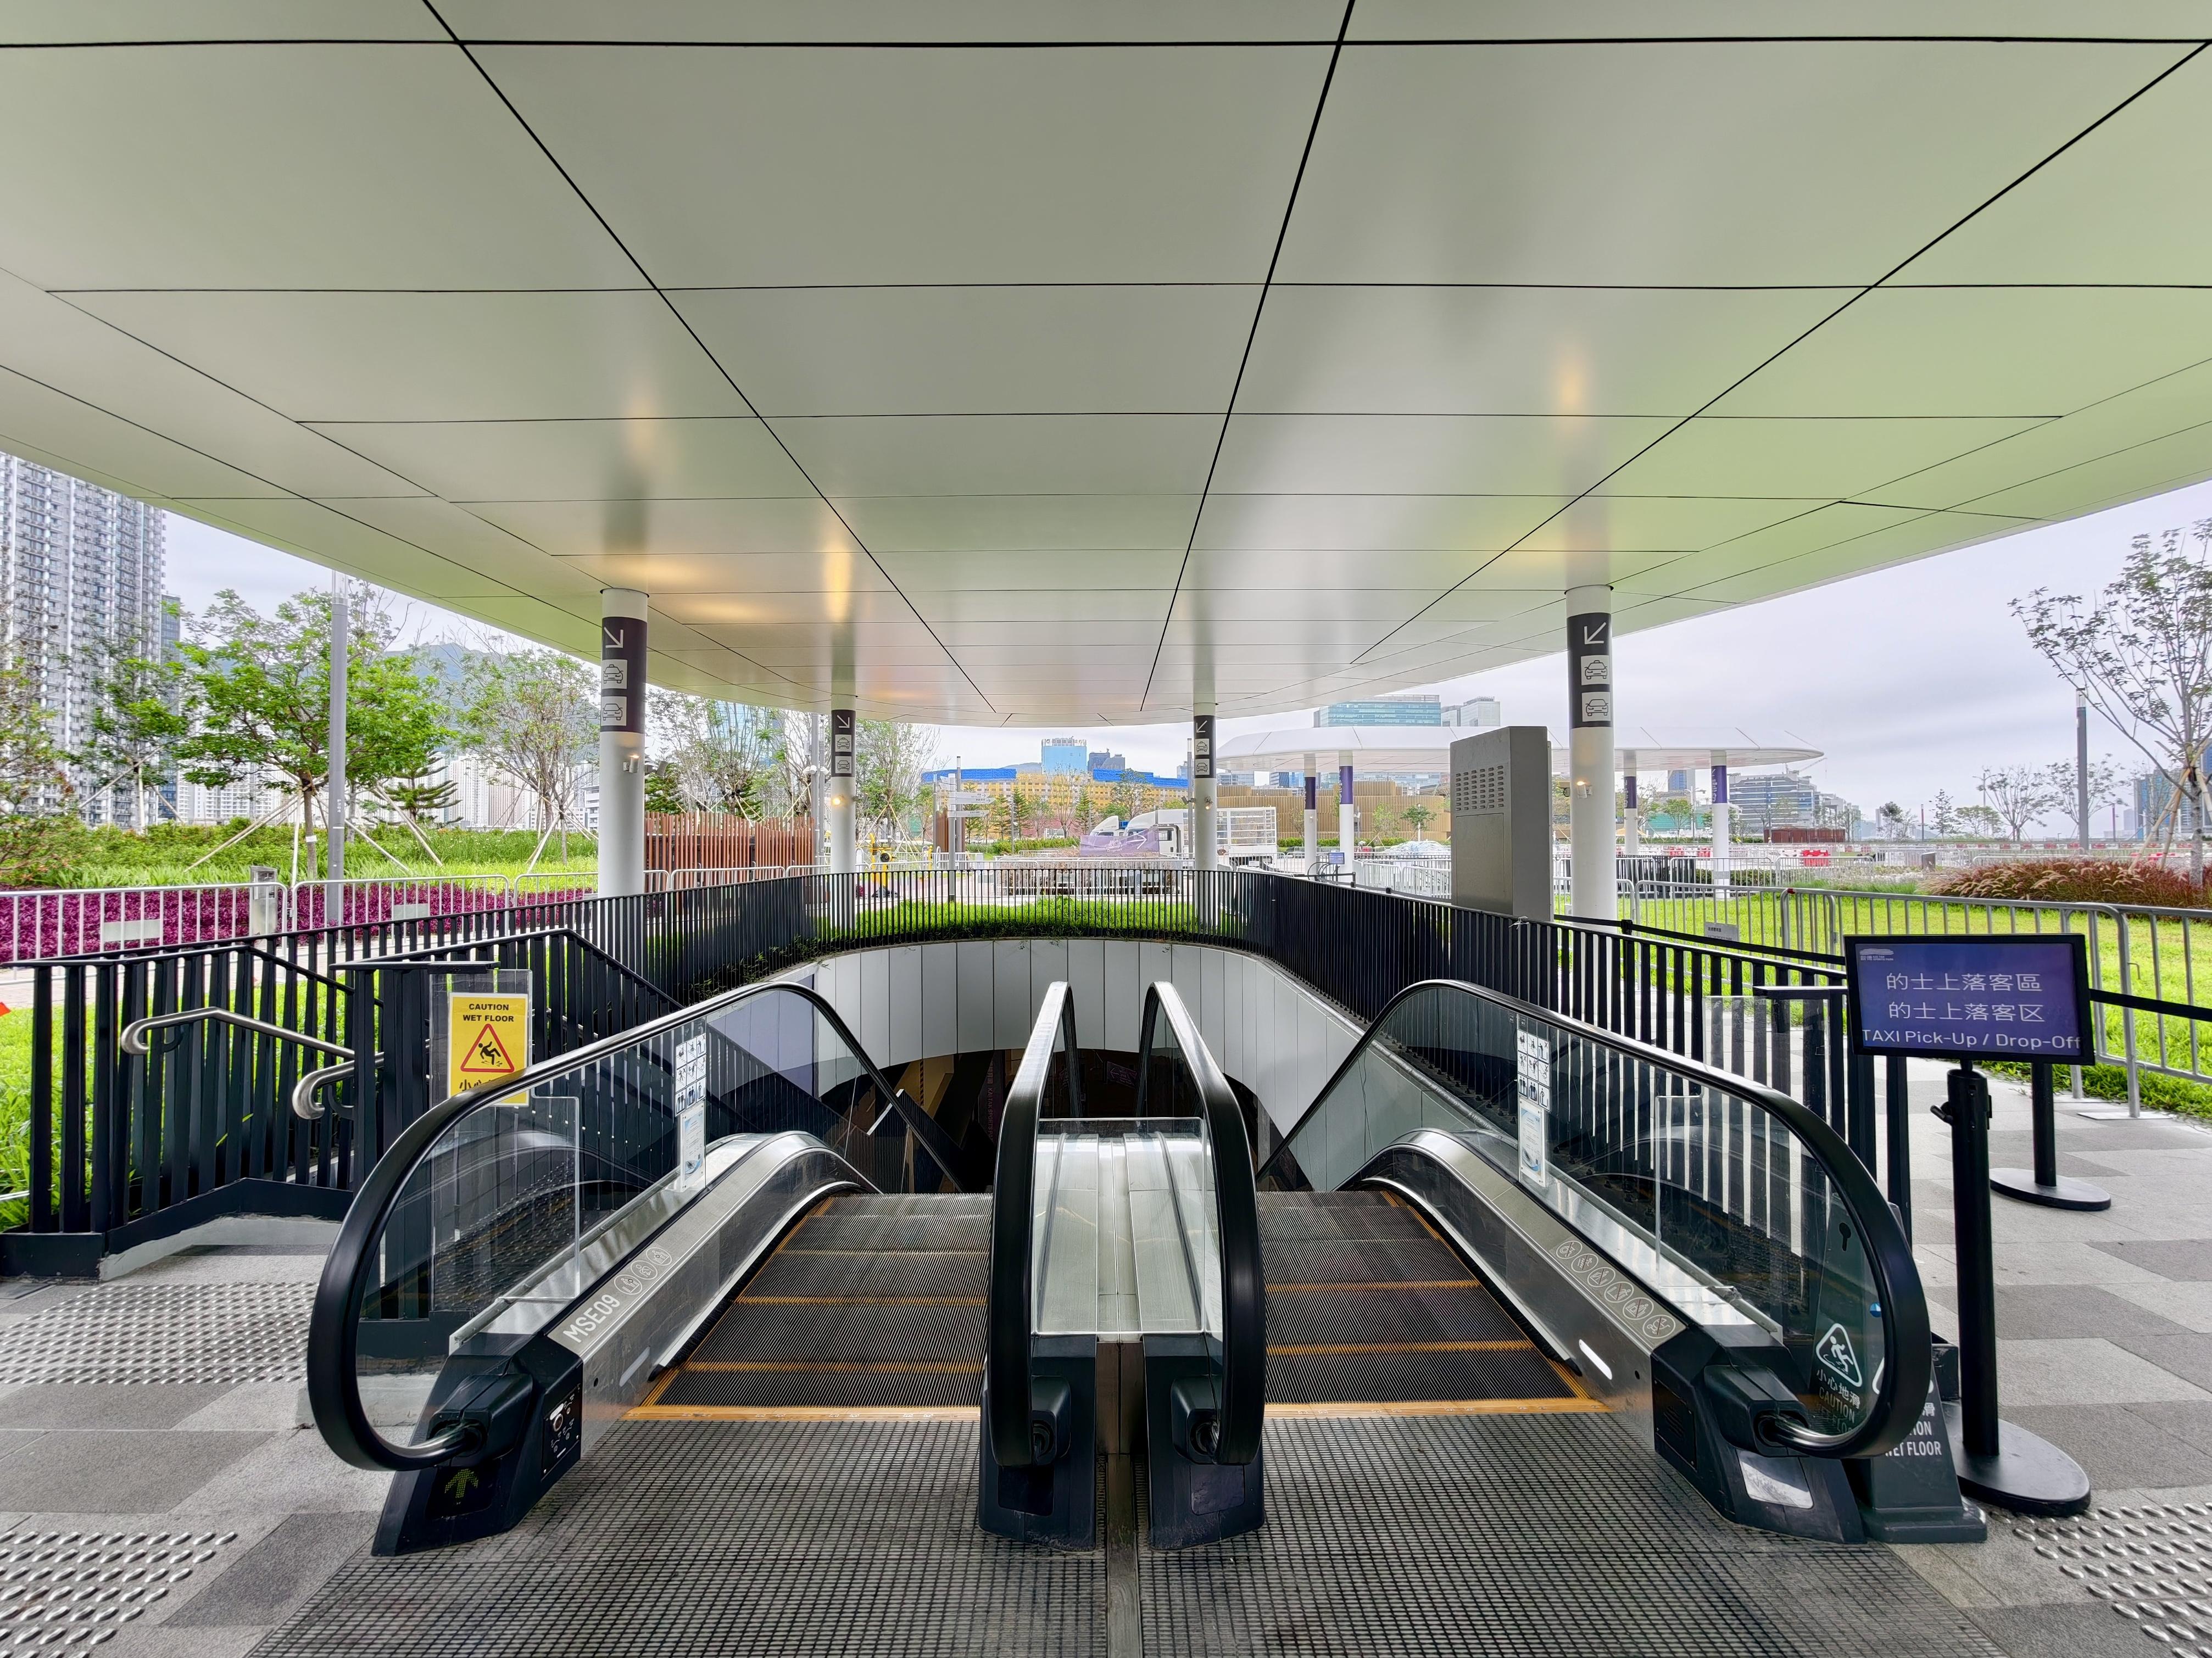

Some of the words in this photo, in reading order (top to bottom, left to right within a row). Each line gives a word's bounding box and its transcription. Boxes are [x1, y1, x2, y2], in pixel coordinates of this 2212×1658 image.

[1886, 972, 2043, 992] 的士上落客區
[1888, 1001, 2045, 1022] 的士上落客区
[1862, 1029, 1900, 1042] TAXI
[1905, 1031, 1977, 1048] Pick-Up
[1982, 1033, 1990, 1046] /
[1996, 1034, 2081, 1050] Drop-Off
[562, 1294, 621, 1343] MSE09
[1816, 1369, 1860, 1409] 小心地滑
[1819, 1386, 1855, 1424] CAUTION
[1907, 1441, 1942, 1456] FLOOR
